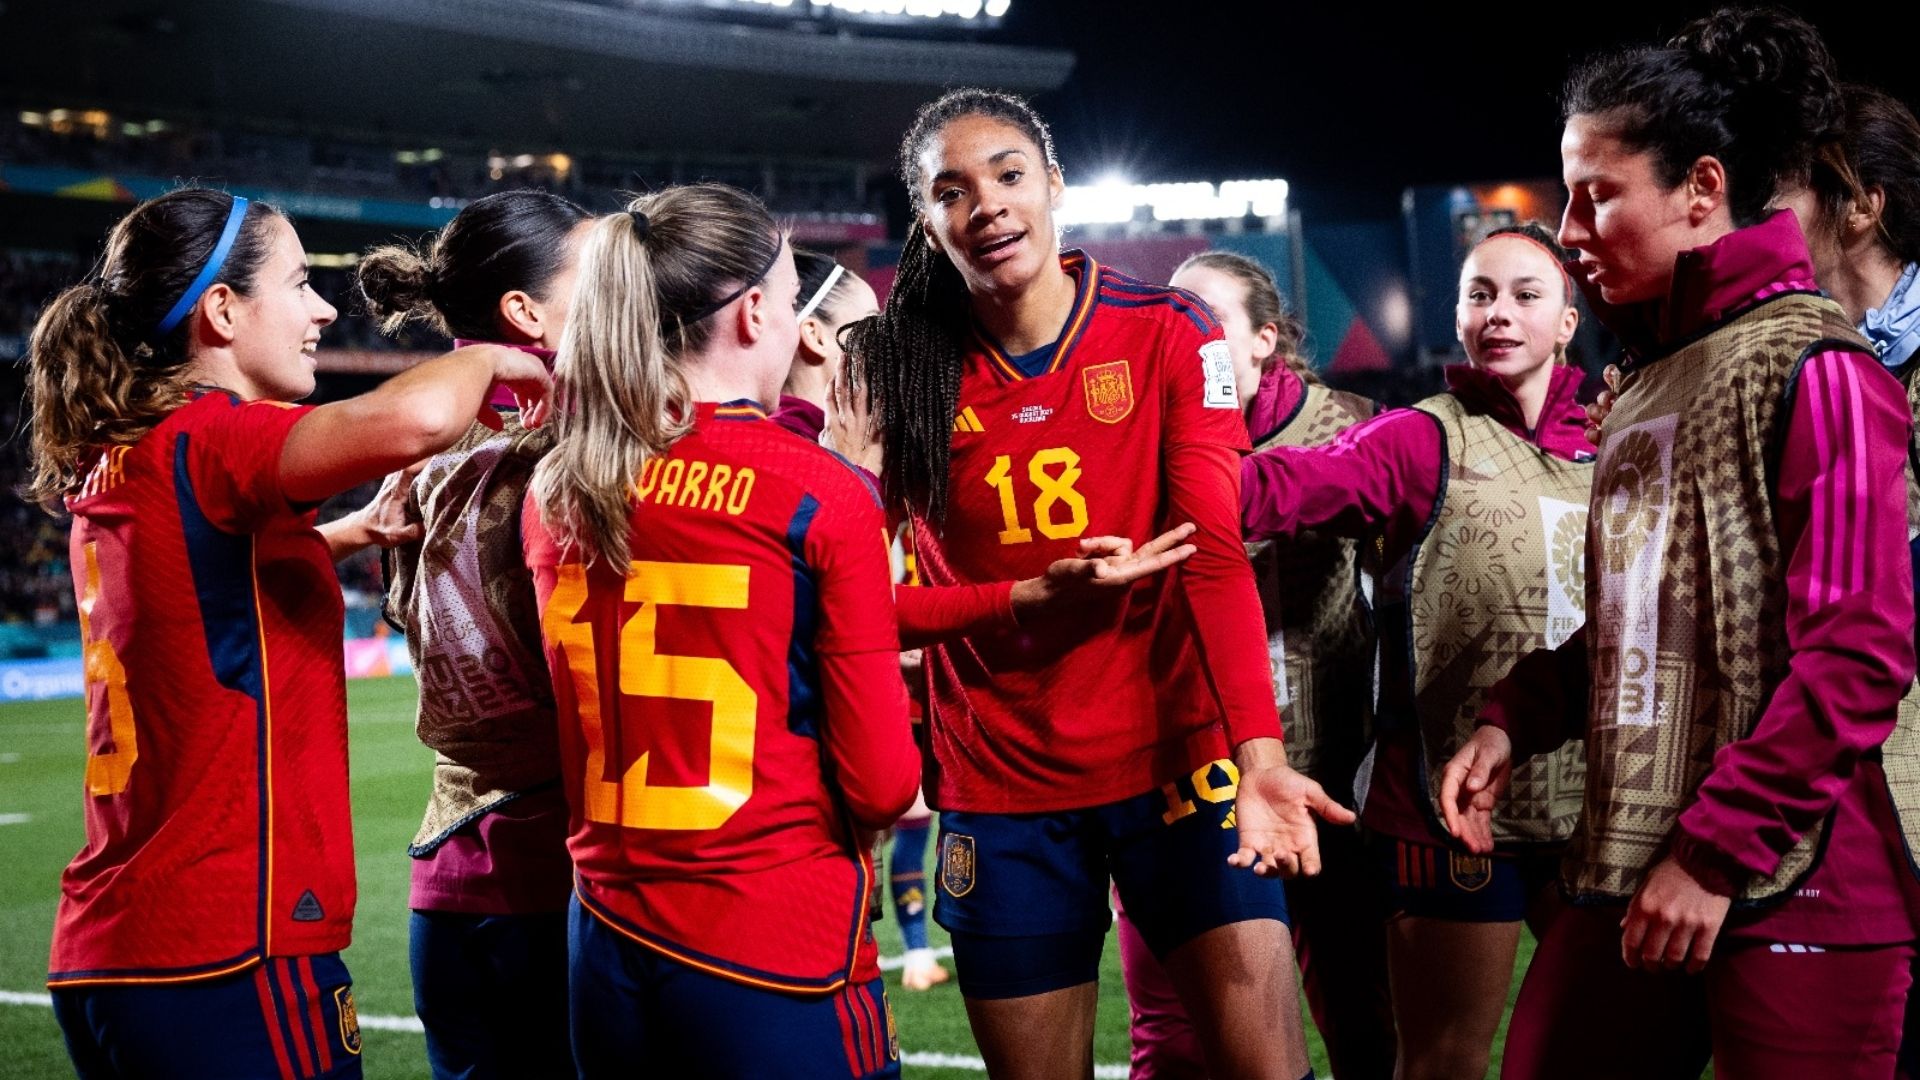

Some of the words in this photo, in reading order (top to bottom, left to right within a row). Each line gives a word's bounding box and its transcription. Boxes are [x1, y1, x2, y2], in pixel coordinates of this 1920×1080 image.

[630, 458, 756, 516] VARRO
[984, 446, 1089, 545] 18
[542, 560, 758, 831] 15
